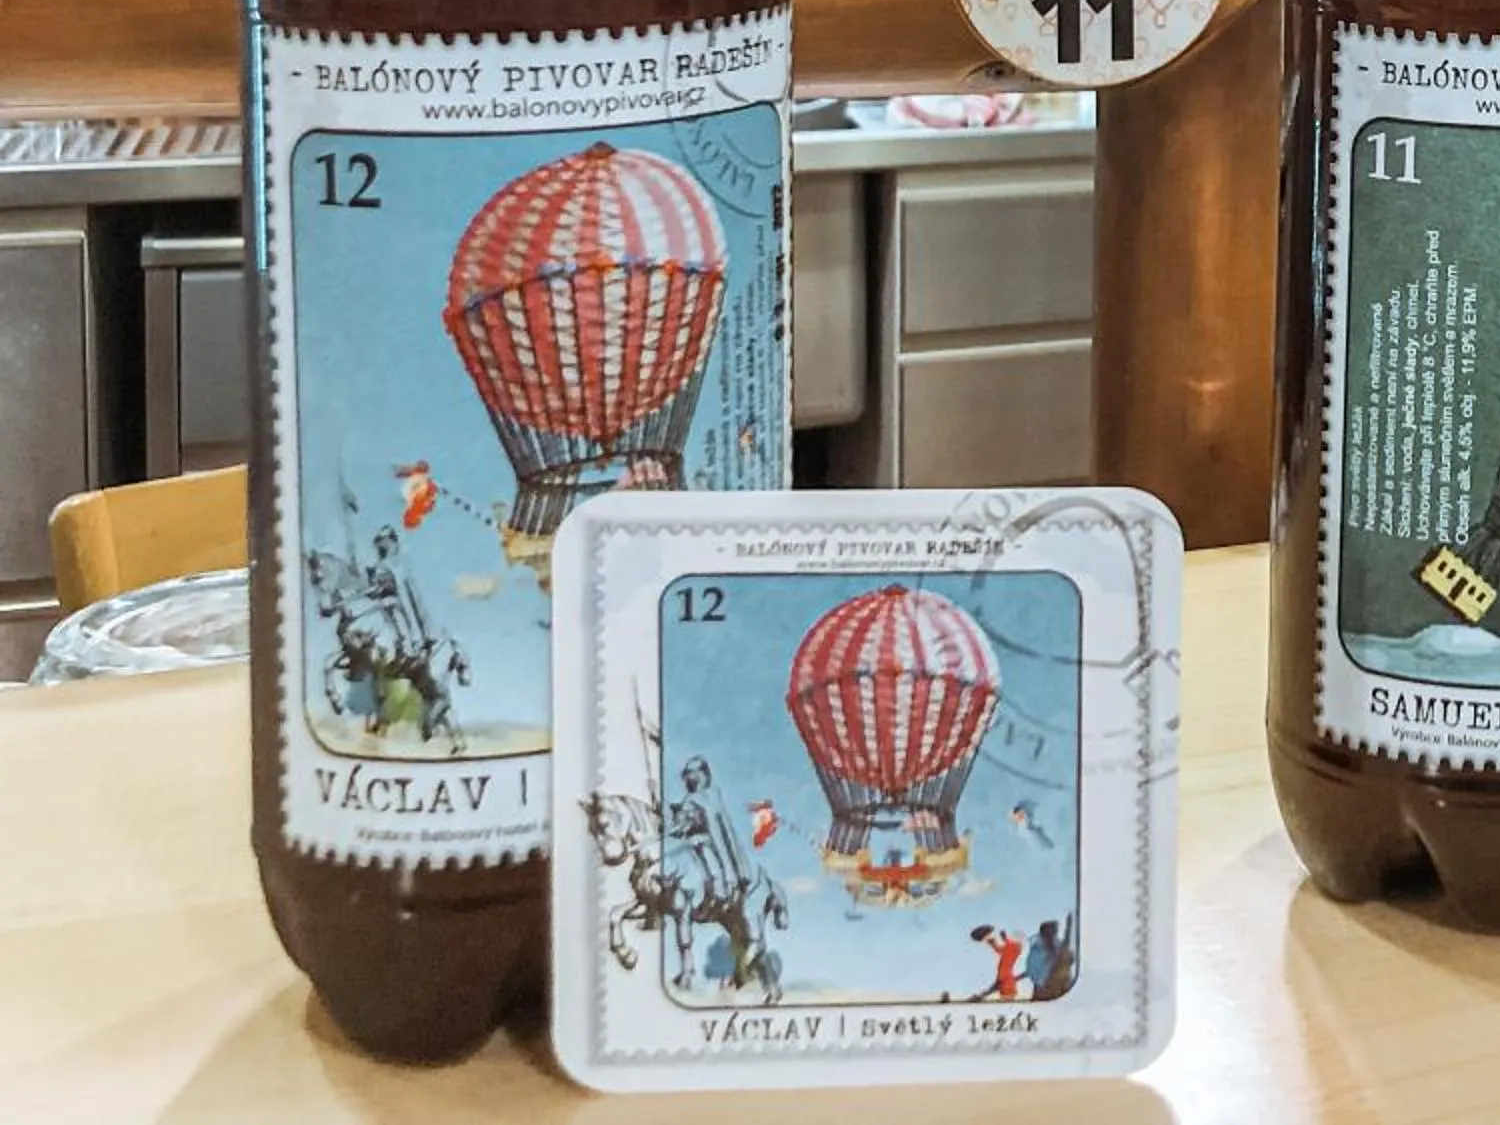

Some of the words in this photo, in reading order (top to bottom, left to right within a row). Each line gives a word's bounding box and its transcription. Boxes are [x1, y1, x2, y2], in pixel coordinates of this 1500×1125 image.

[315, 62, 482, 94] BALÓNOVÝ
[503, 58, 659, 92] PIVOVAR
[1366, 132, 1422, 184] 11
[315, 152, 382, 208] 12
[1426, 230, 1441, 264] před
[837, 540, 917, 556] PIVOVAR
[676, 587, 726, 623] 12
[315, 764, 491, 813] VÁCLAV
[700, 1011, 822, 1044] VÁCLAV
[861, 1012, 953, 1042] Světlý
[967, 1010, 1040, 1035] ležák
